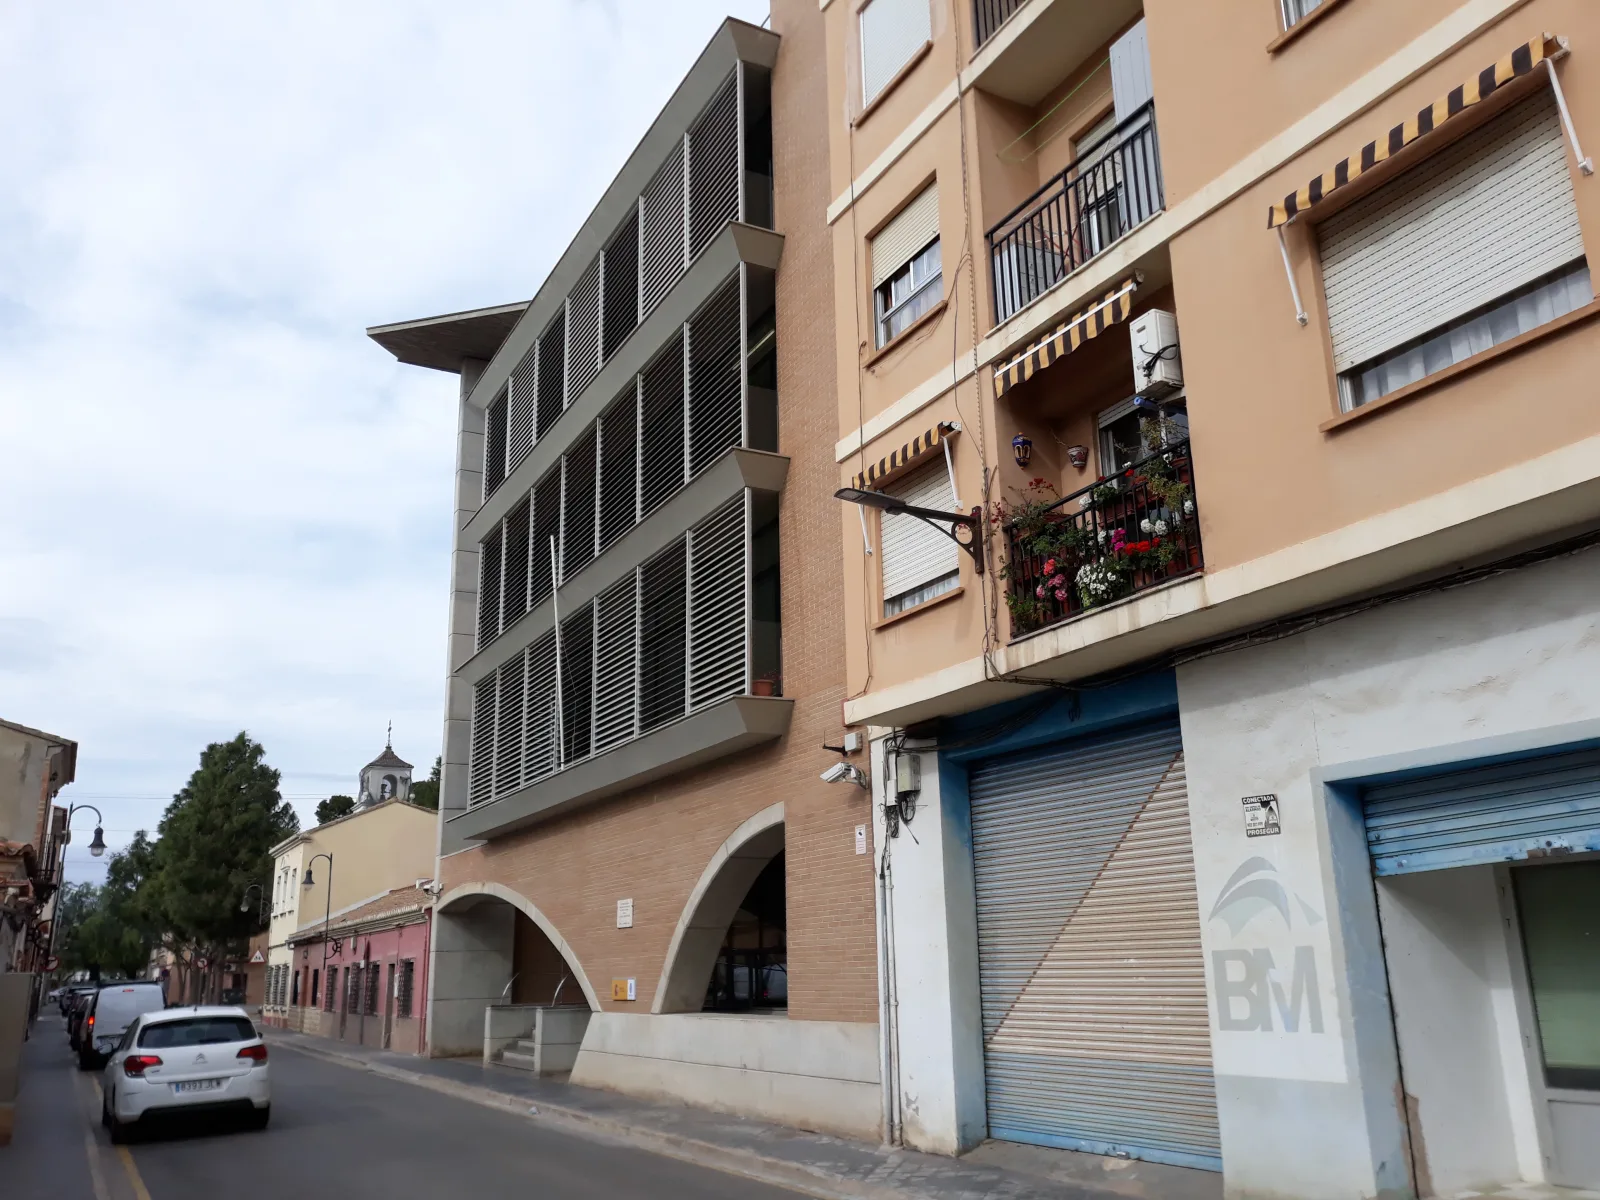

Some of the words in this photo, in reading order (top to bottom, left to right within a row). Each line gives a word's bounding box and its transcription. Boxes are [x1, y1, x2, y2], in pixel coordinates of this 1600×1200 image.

[1242, 795, 1274, 804] CONECTADA
[1247, 827, 1279, 836] PROSEGUR
[1211, 945, 1325, 1034] BM
